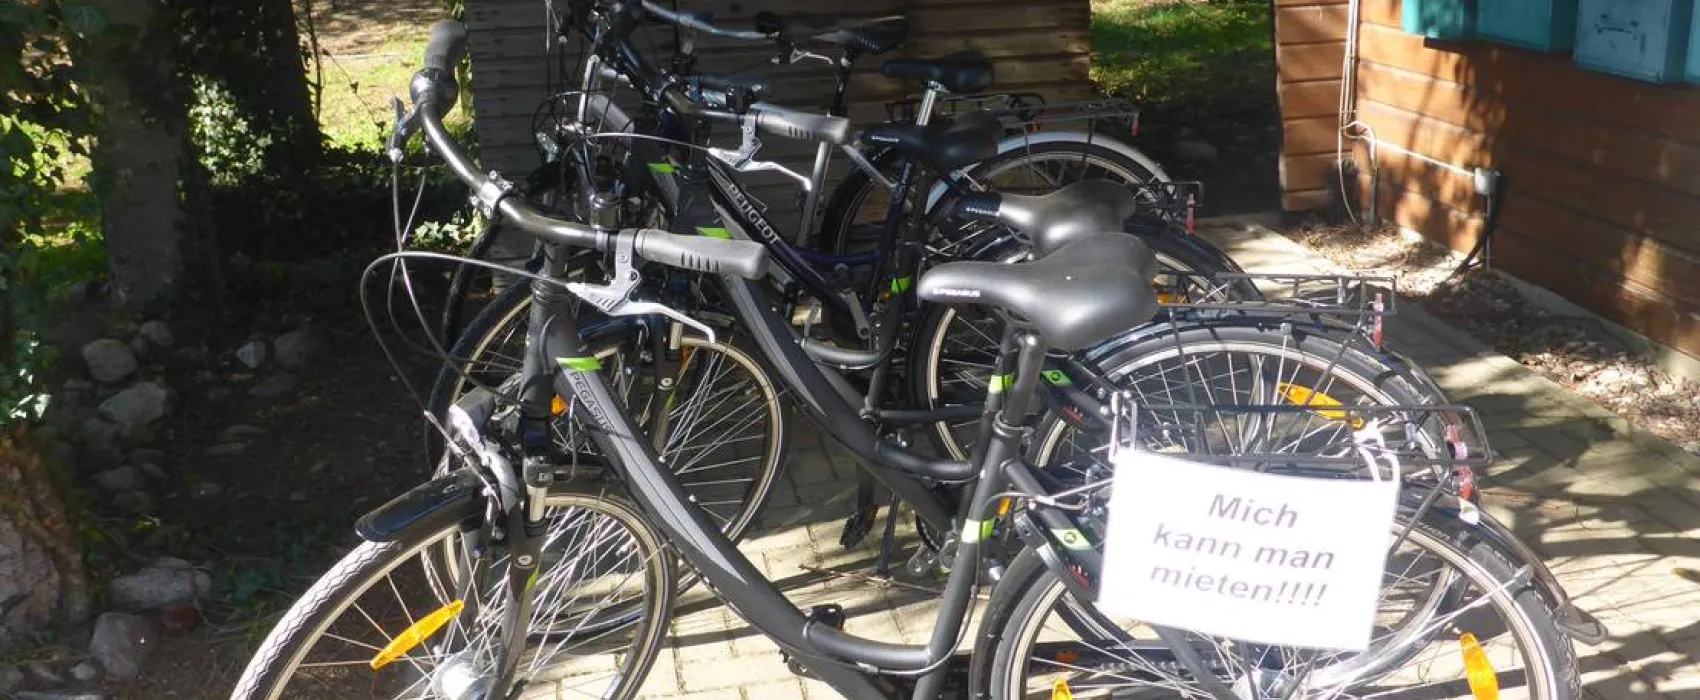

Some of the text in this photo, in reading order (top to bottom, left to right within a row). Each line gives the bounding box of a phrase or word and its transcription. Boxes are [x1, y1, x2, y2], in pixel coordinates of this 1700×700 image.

[728, 183, 781, 243] PEUGEOT
[570, 371, 612, 434] PEGASUS
[1208, 494, 1298, 528] Mich
[1153, 523, 1335, 569] kann man
[1150, 565, 1328, 607] mieten!!!!
